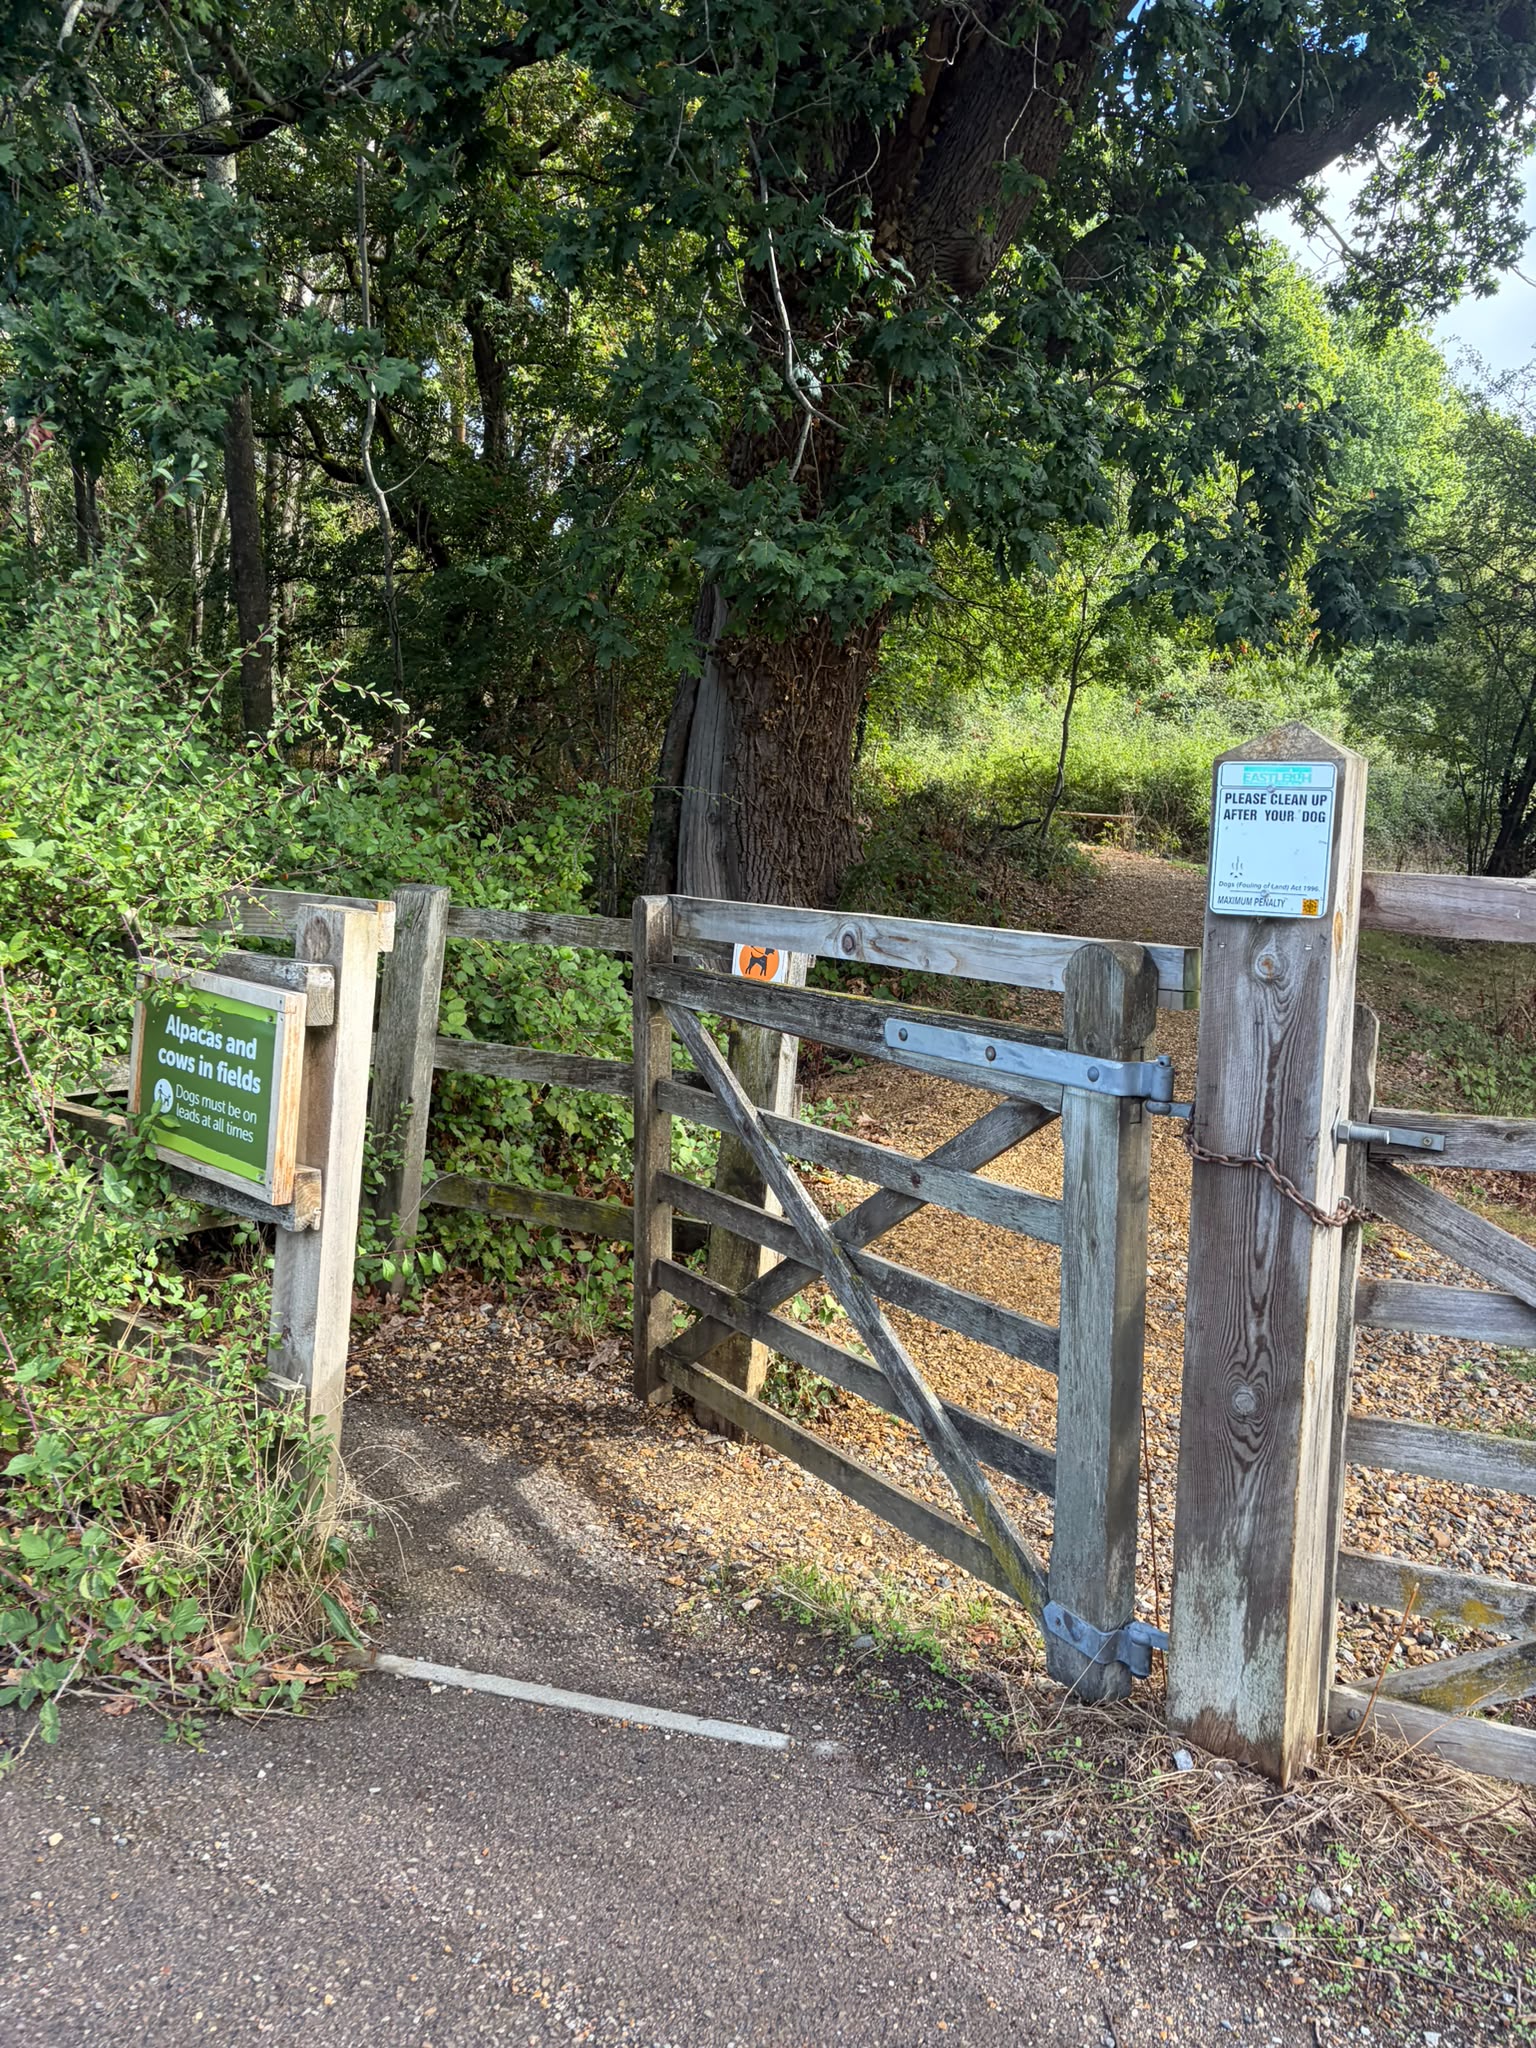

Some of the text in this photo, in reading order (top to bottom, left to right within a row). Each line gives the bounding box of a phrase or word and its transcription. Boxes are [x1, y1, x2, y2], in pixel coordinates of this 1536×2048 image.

[1225, 793, 1327, 806] PLEASE CLEAN UP
[1223, 809, 1326, 823] AFTER YOUR DOG
[1236, 881, 1262, 890] (Fouling
[1271, 882, 1290, 891] Land)
[1290, 883, 1302, 891] Act
[1217, 895, 1286, 908] MAXIMUM PENALTY
[165, 1013, 257, 1060] Alpacas and
[158, 1047, 261, 1094] cows in fields
[175, 1083, 257, 1124] Dogs must be on
[176, 1102, 254, 1143] leads at all times
